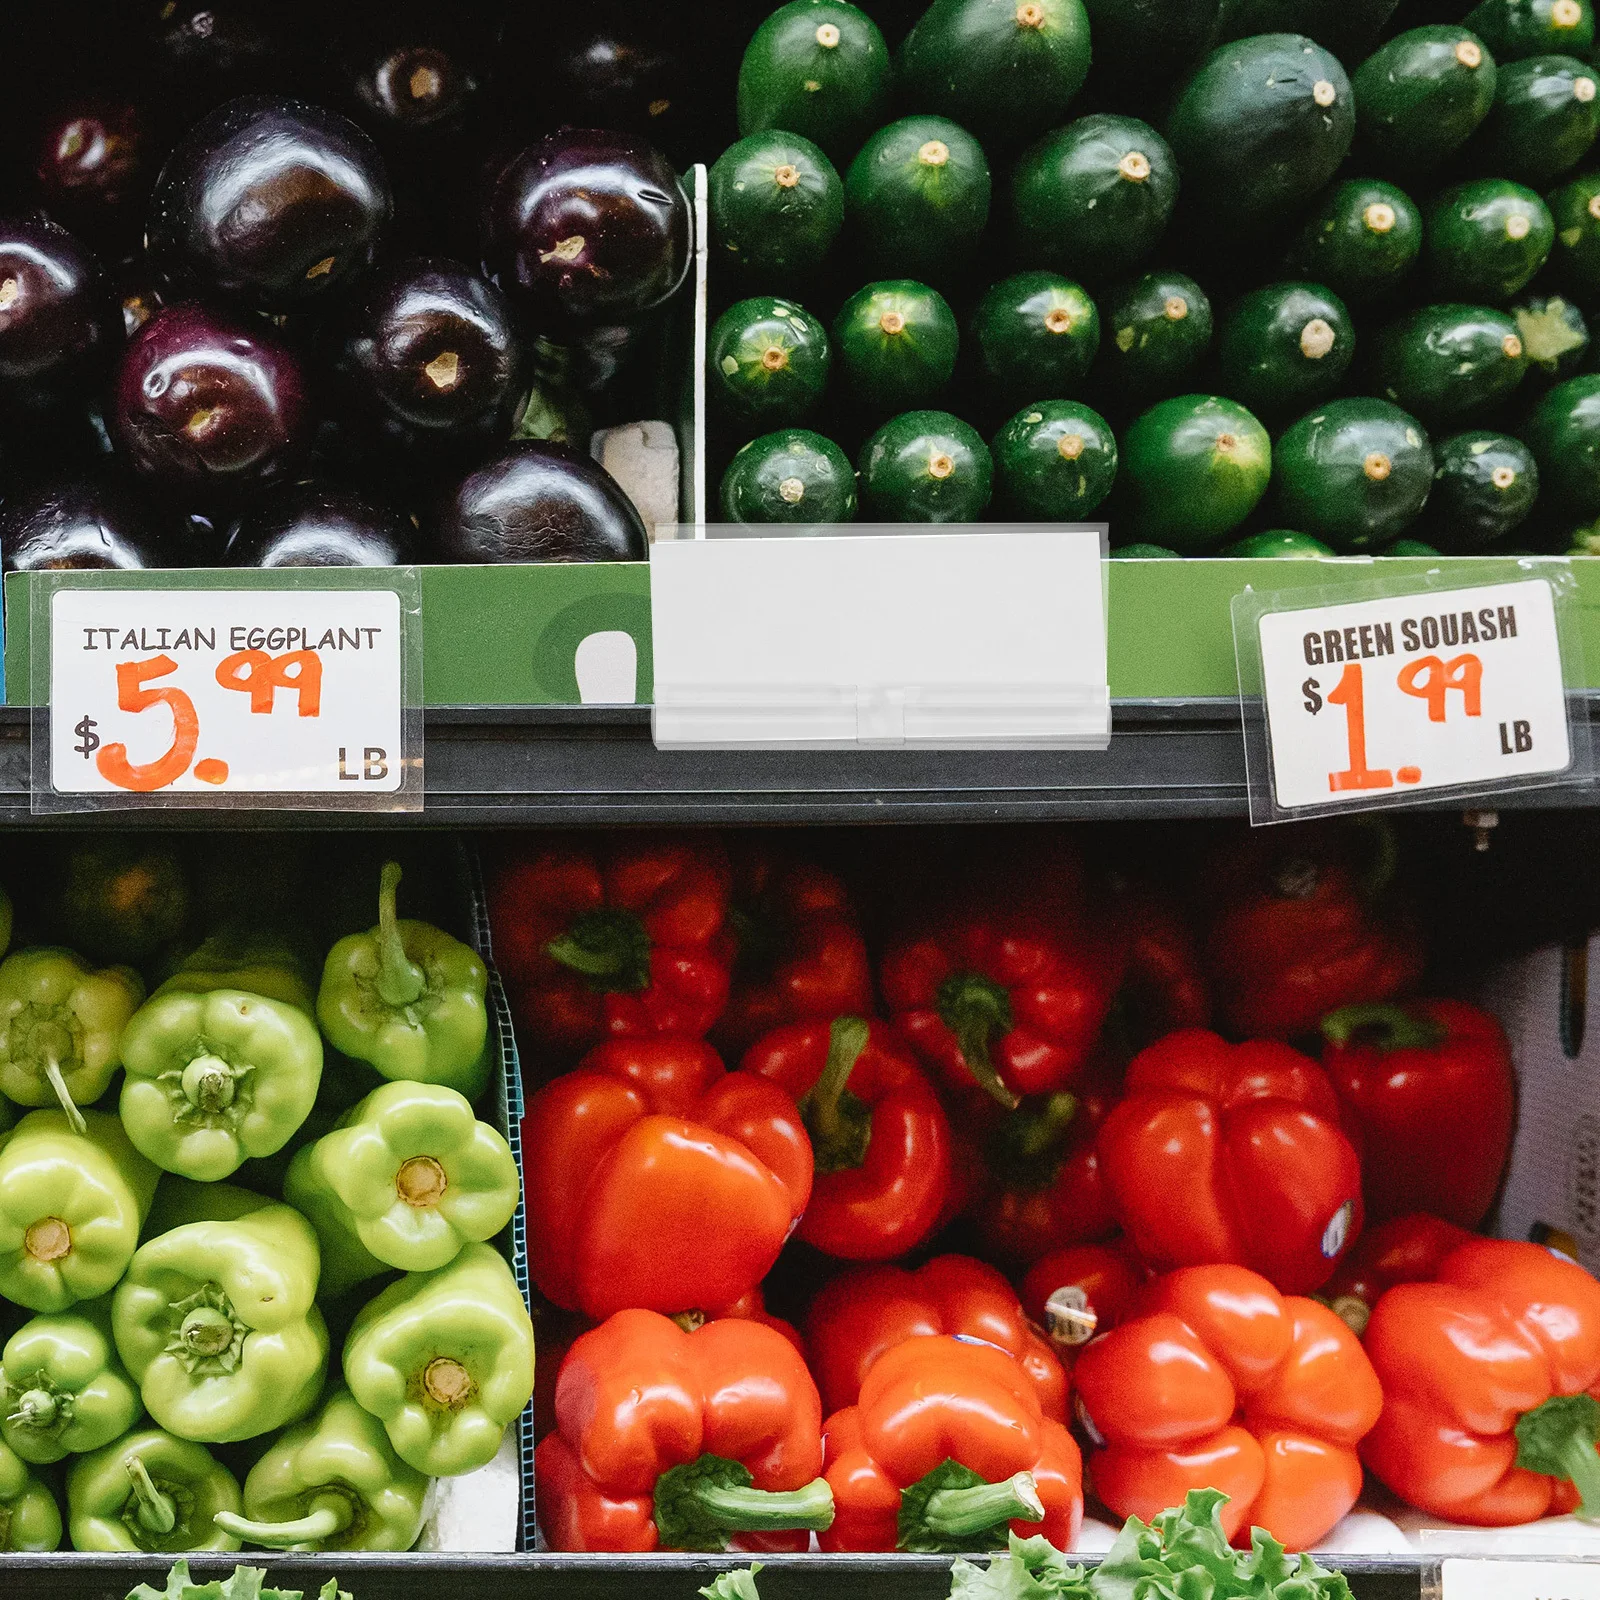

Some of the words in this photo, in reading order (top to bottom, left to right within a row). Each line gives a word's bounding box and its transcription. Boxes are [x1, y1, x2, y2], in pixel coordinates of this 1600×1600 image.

[83, 627, 216, 651] ITALIAN
[230, 626, 382, 652] EGGPLANT
[1303, 622, 1395, 667] GREEN
[1499, 720, 1533, 756] LB
[338, 747, 389, 781] LB
